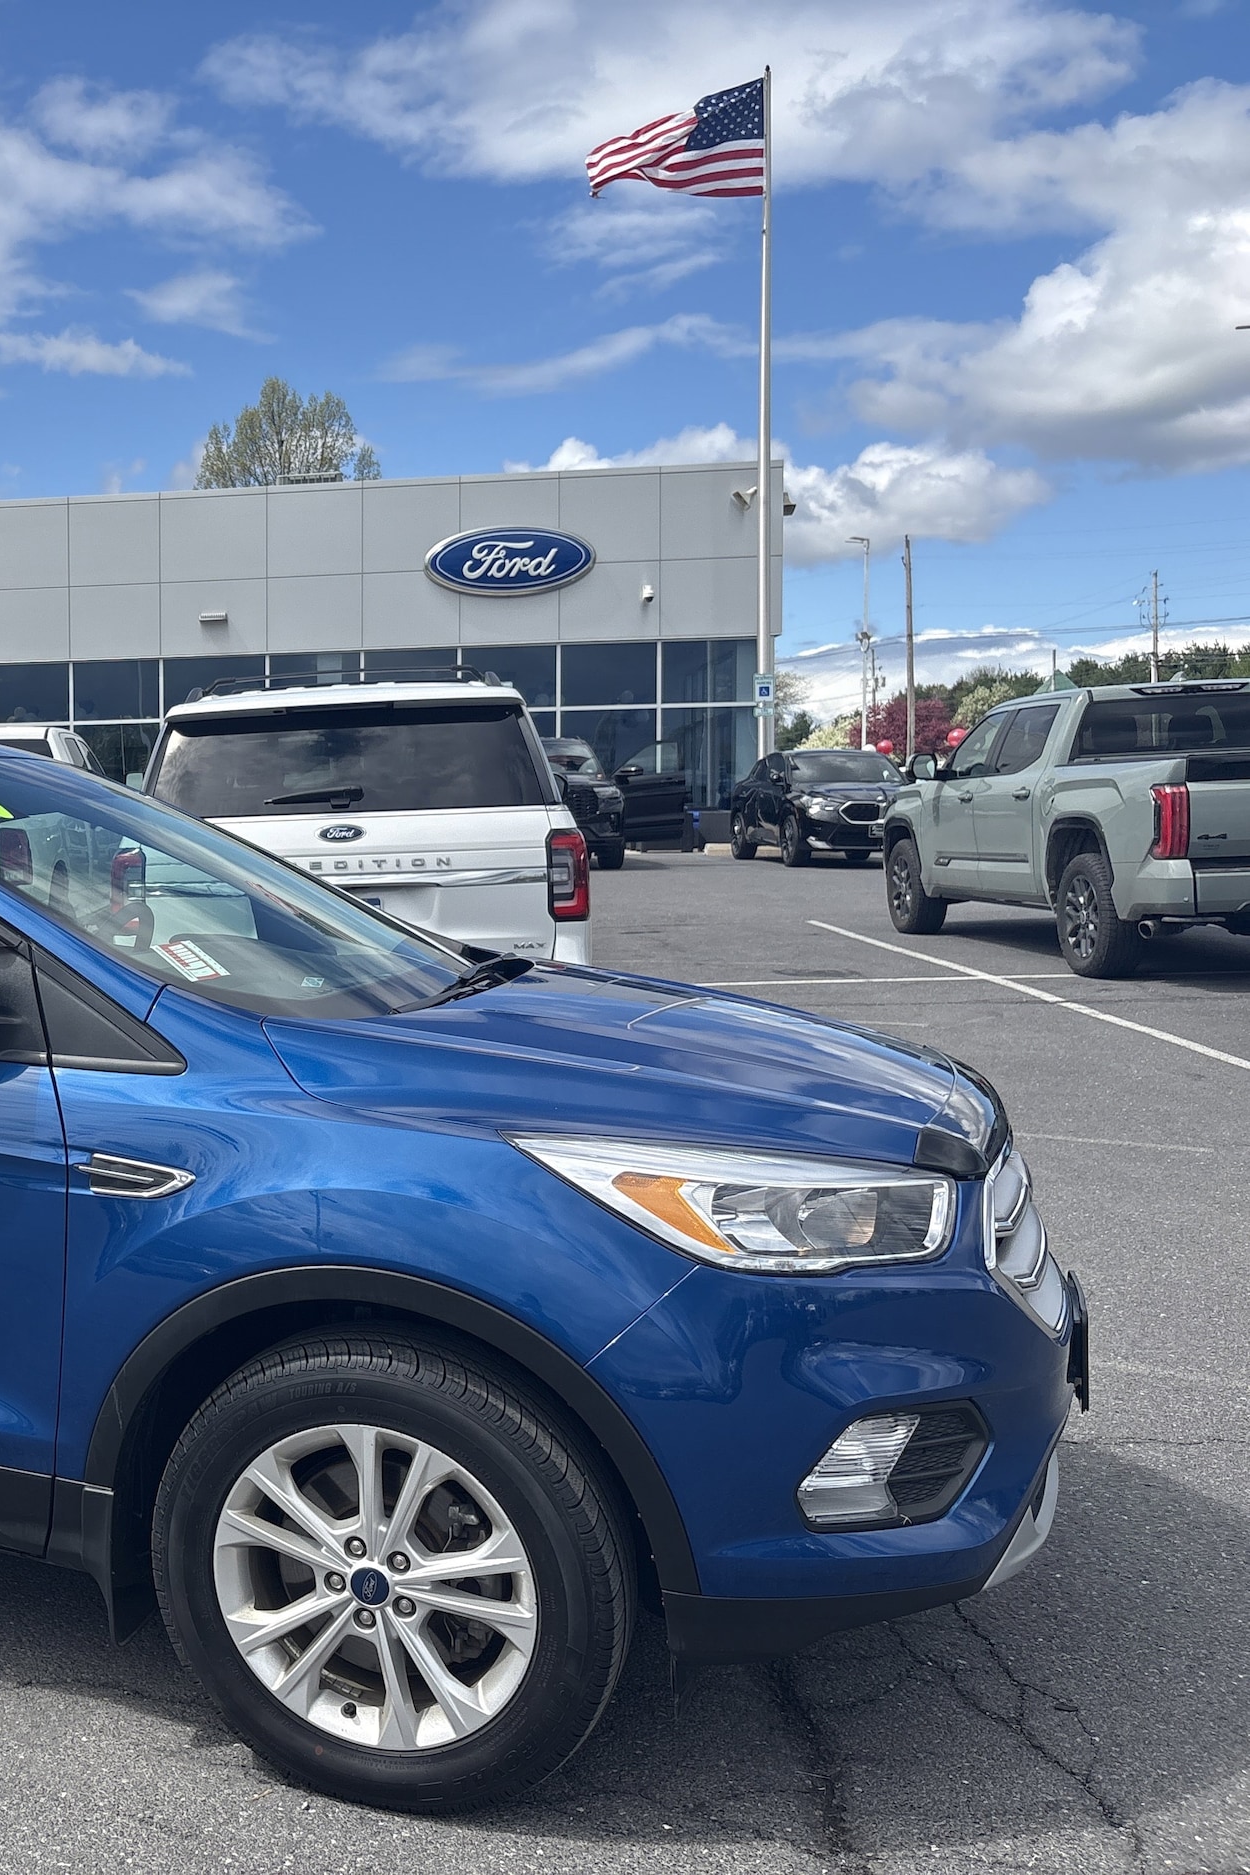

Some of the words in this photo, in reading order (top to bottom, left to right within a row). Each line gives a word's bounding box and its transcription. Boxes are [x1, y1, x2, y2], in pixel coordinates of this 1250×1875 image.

[462, 540, 558, 580] Ford
[326, 827, 355, 839] Ford
[308, 857, 451, 871] EDITION
[513, 942, 547, 950] MAX
[289, 1382, 332, 1399] TOURING
[336, 1381, 357, 1394] A/S
